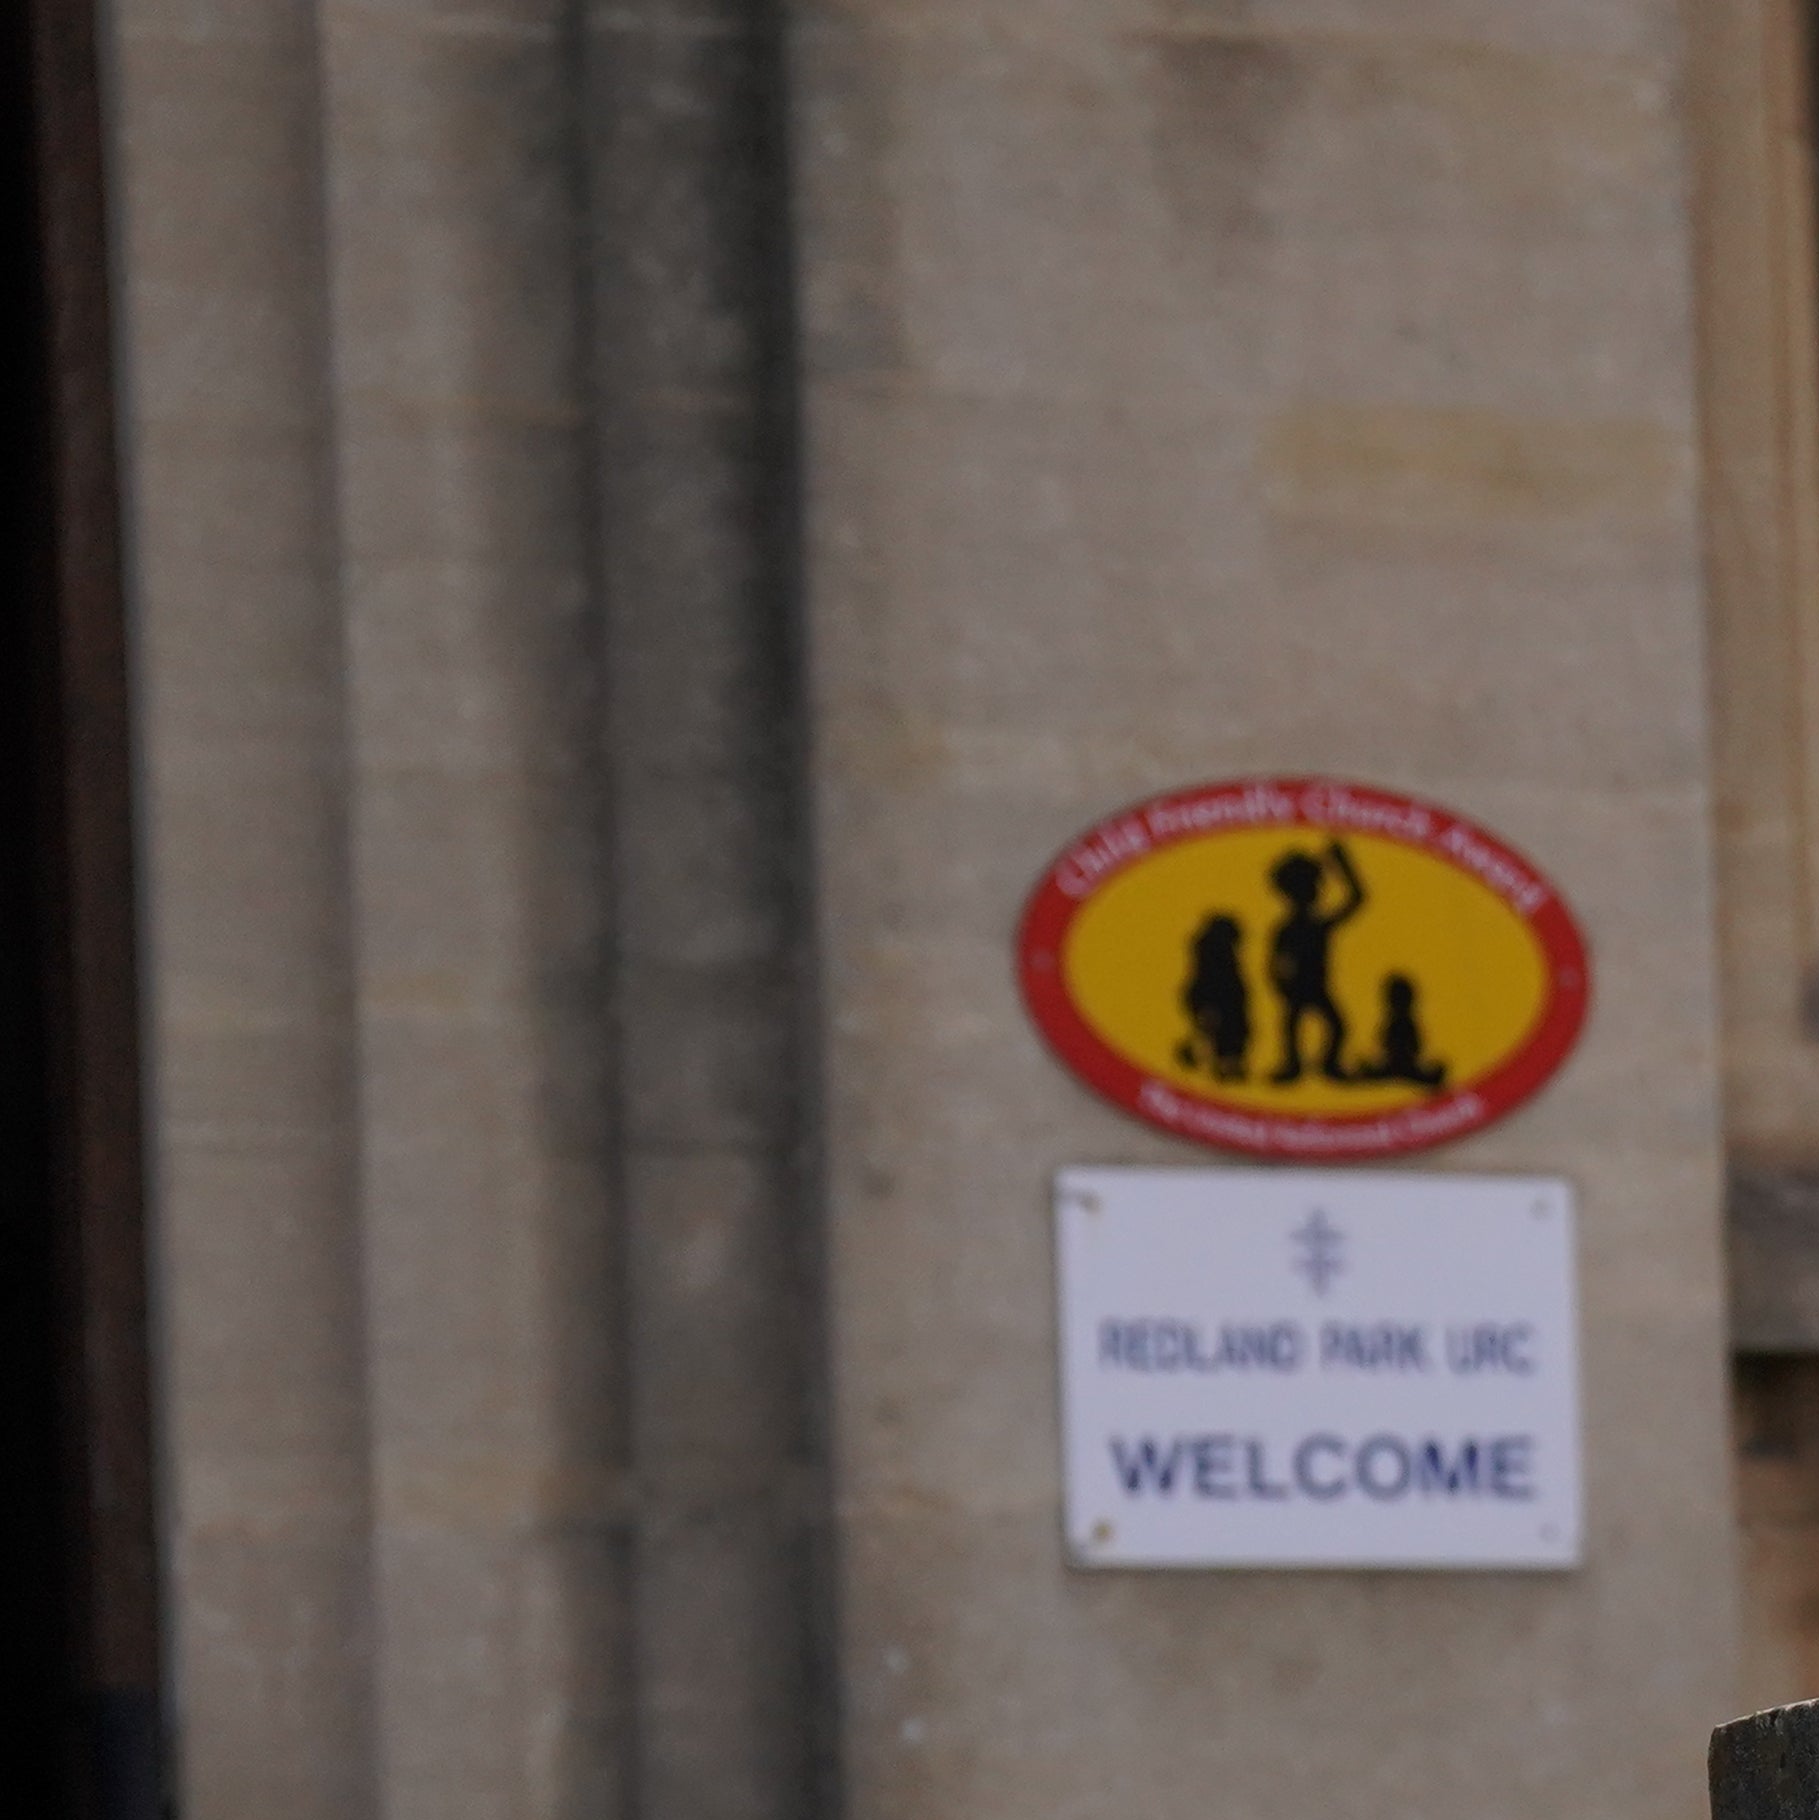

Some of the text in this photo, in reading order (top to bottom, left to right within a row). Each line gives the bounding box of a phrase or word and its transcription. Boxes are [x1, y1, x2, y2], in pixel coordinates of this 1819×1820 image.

[1099, 1317, 1535, 1376] REDLAND PARK URC
[1107, 1433, 1535, 1502] WELCOME
